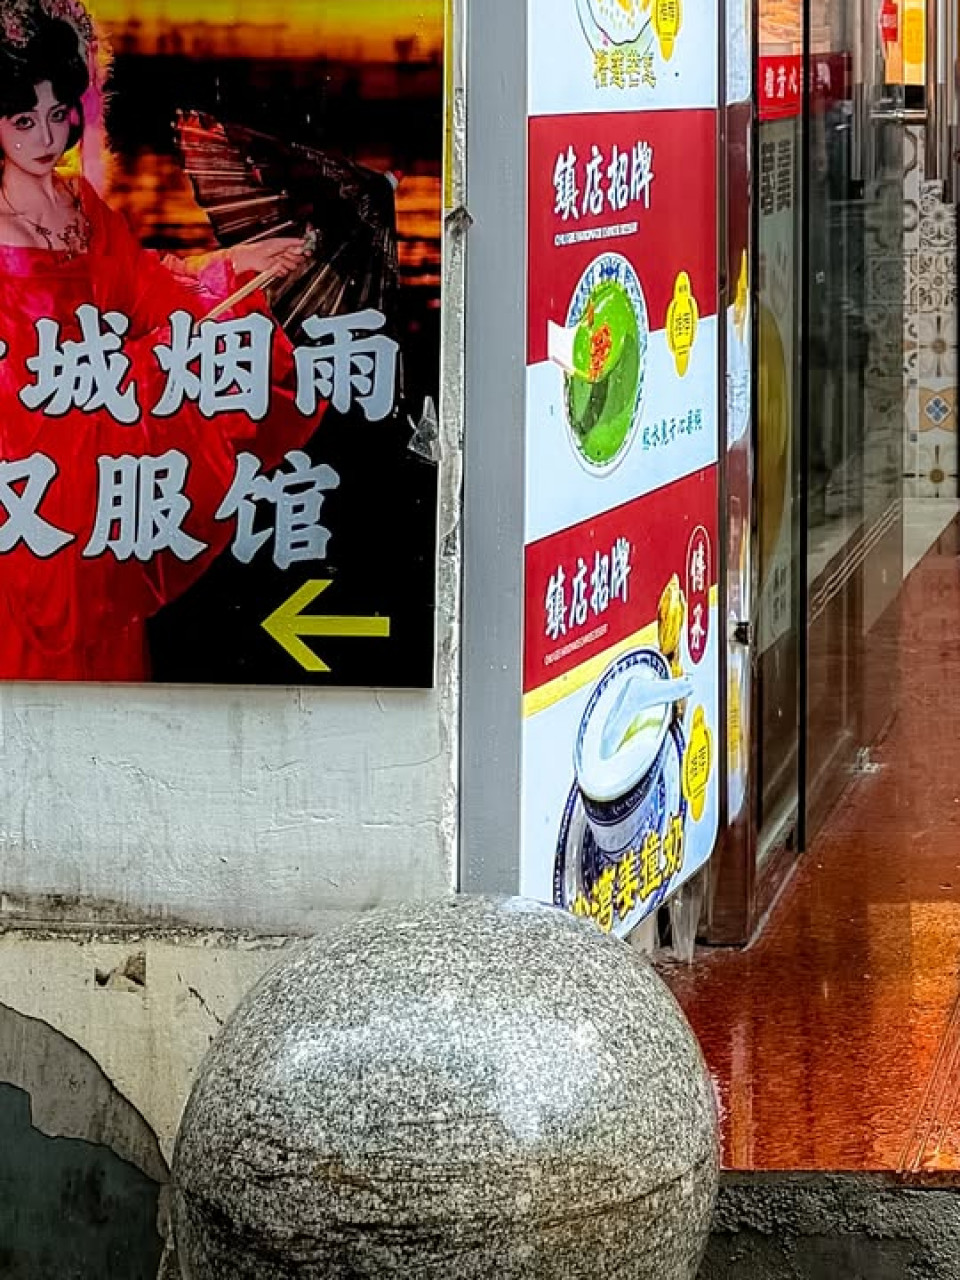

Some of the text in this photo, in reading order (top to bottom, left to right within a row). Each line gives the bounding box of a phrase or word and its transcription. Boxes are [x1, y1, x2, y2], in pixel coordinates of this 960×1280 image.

[552, 141, 655, 221] 鎮店招牌
[0, 303, 401, 423] 城烟雨
[543, 536, 633, 640] 鎮店招牌
